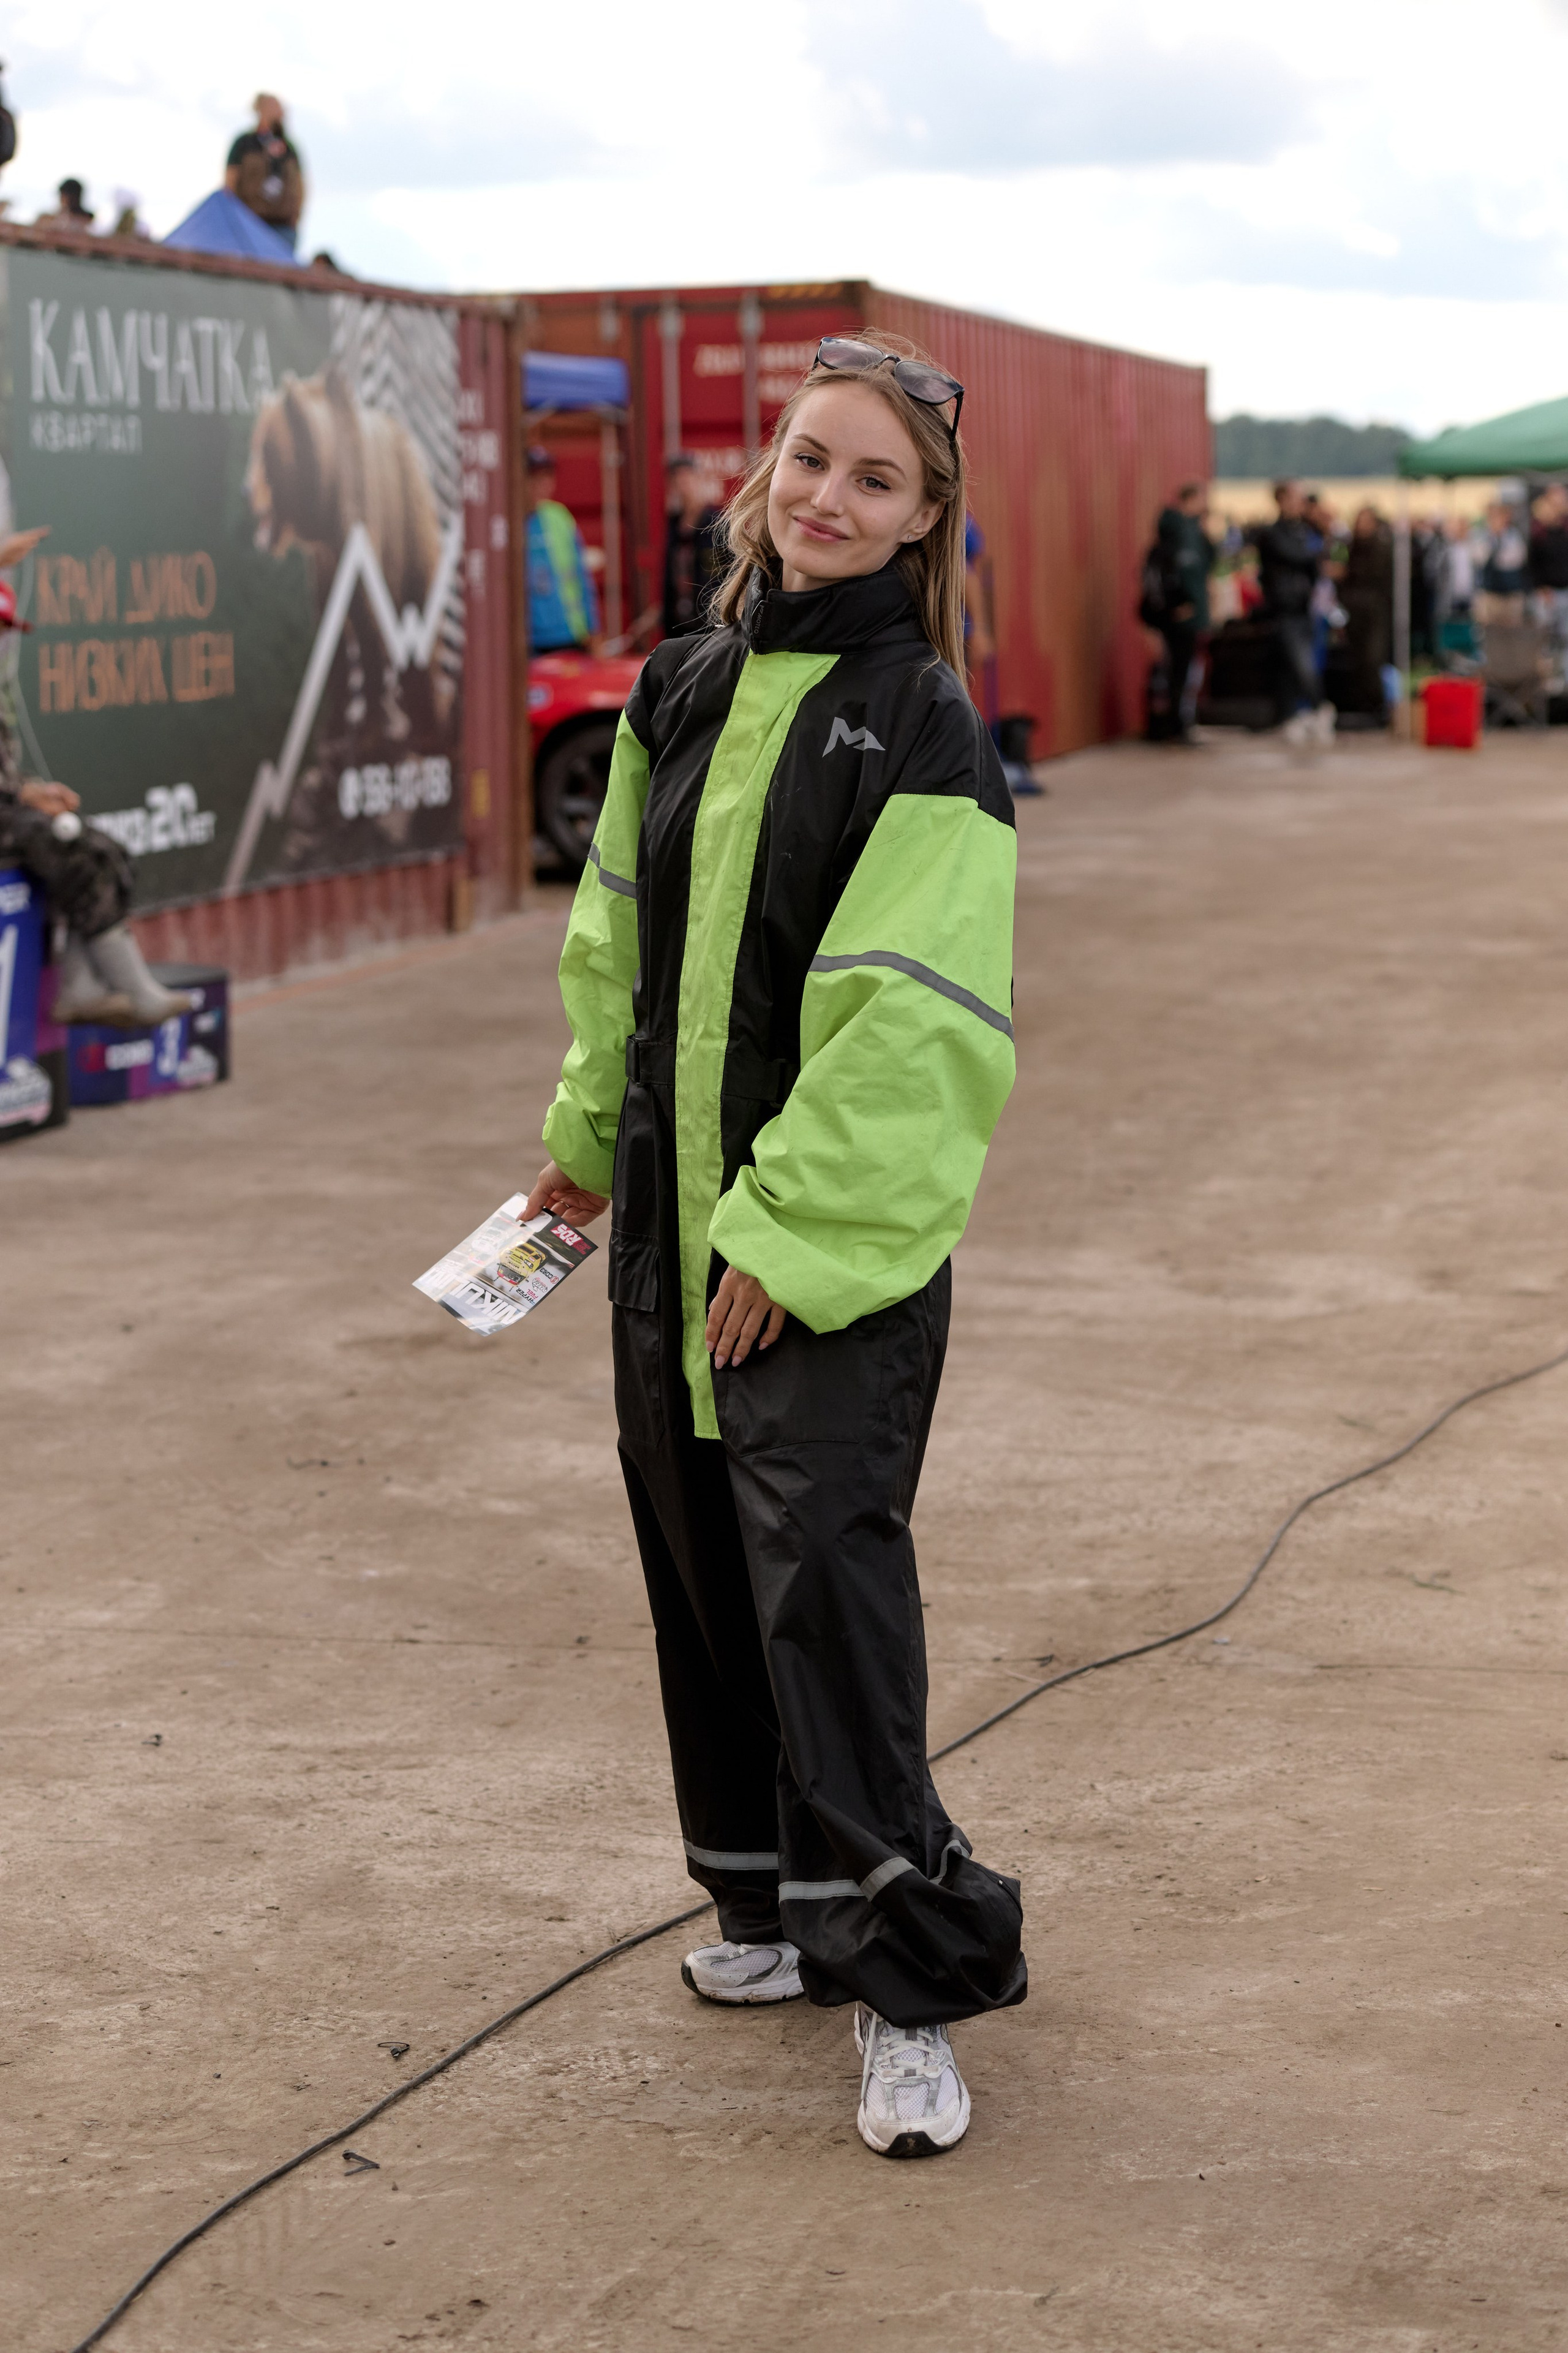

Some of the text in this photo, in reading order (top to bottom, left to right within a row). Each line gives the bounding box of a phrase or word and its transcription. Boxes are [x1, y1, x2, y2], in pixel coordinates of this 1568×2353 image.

[29, 298, 274, 414] КАМЧАТКА
[29, 412, 142, 454] КВАРТАЛ
[36, 546, 217, 625] КРАЙ ДИКО
[39, 632, 235, 712] НИЗКИХ ЦЕН
[551, 1223, 582, 1247] RDS
[516, 1288, 535, 1305] HYPER
[526, 1289, 538, 1299] FUEL
